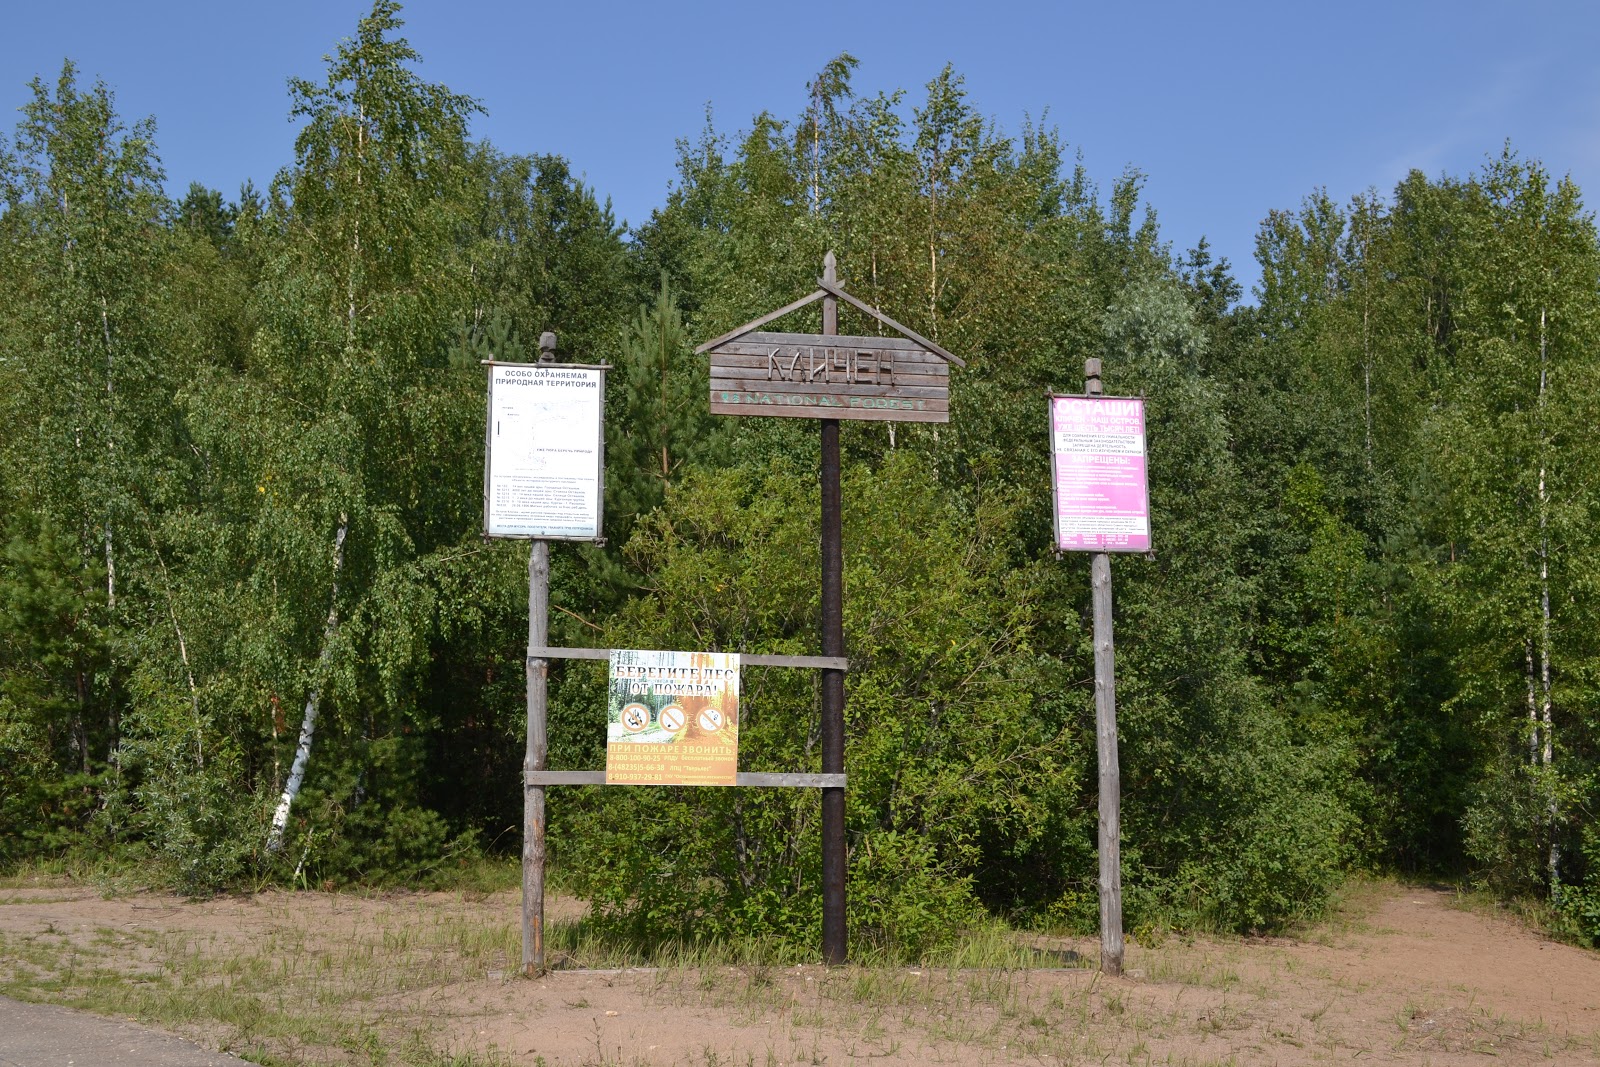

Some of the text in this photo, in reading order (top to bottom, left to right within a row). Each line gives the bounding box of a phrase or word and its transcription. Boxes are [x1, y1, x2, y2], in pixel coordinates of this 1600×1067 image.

[767, 347, 895, 386] КЛИЧЕН
[505, 370, 588, 379] ОСОБО ОХРАНЯЕМАЯ
[495, 378, 597, 388] ПРИРОДНАЯ ТЕРРИТОРИЯ
[745, 394, 925, 410] NATIONAL FOREST
[1057, 399, 1140, 417] ОСТАШИ!
[1071, 455, 1131, 465] ЗАПРЕЩЕНЫ:
[615, 665, 734, 680] БЕРЕГИТЕ ЛЕС
[631, 682, 717, 696] ОТ ПОЖАРА!
[609, 744, 736, 754] ПРИ ПОЖАРЕ ЗВОНИТЬ:
[609, 754, 661, 762] 8-800-100-90-25
[608, 763, 665, 772] 8-(48235)5-66-38
[608, 773, 663, 781] 8-910-937-29-81
